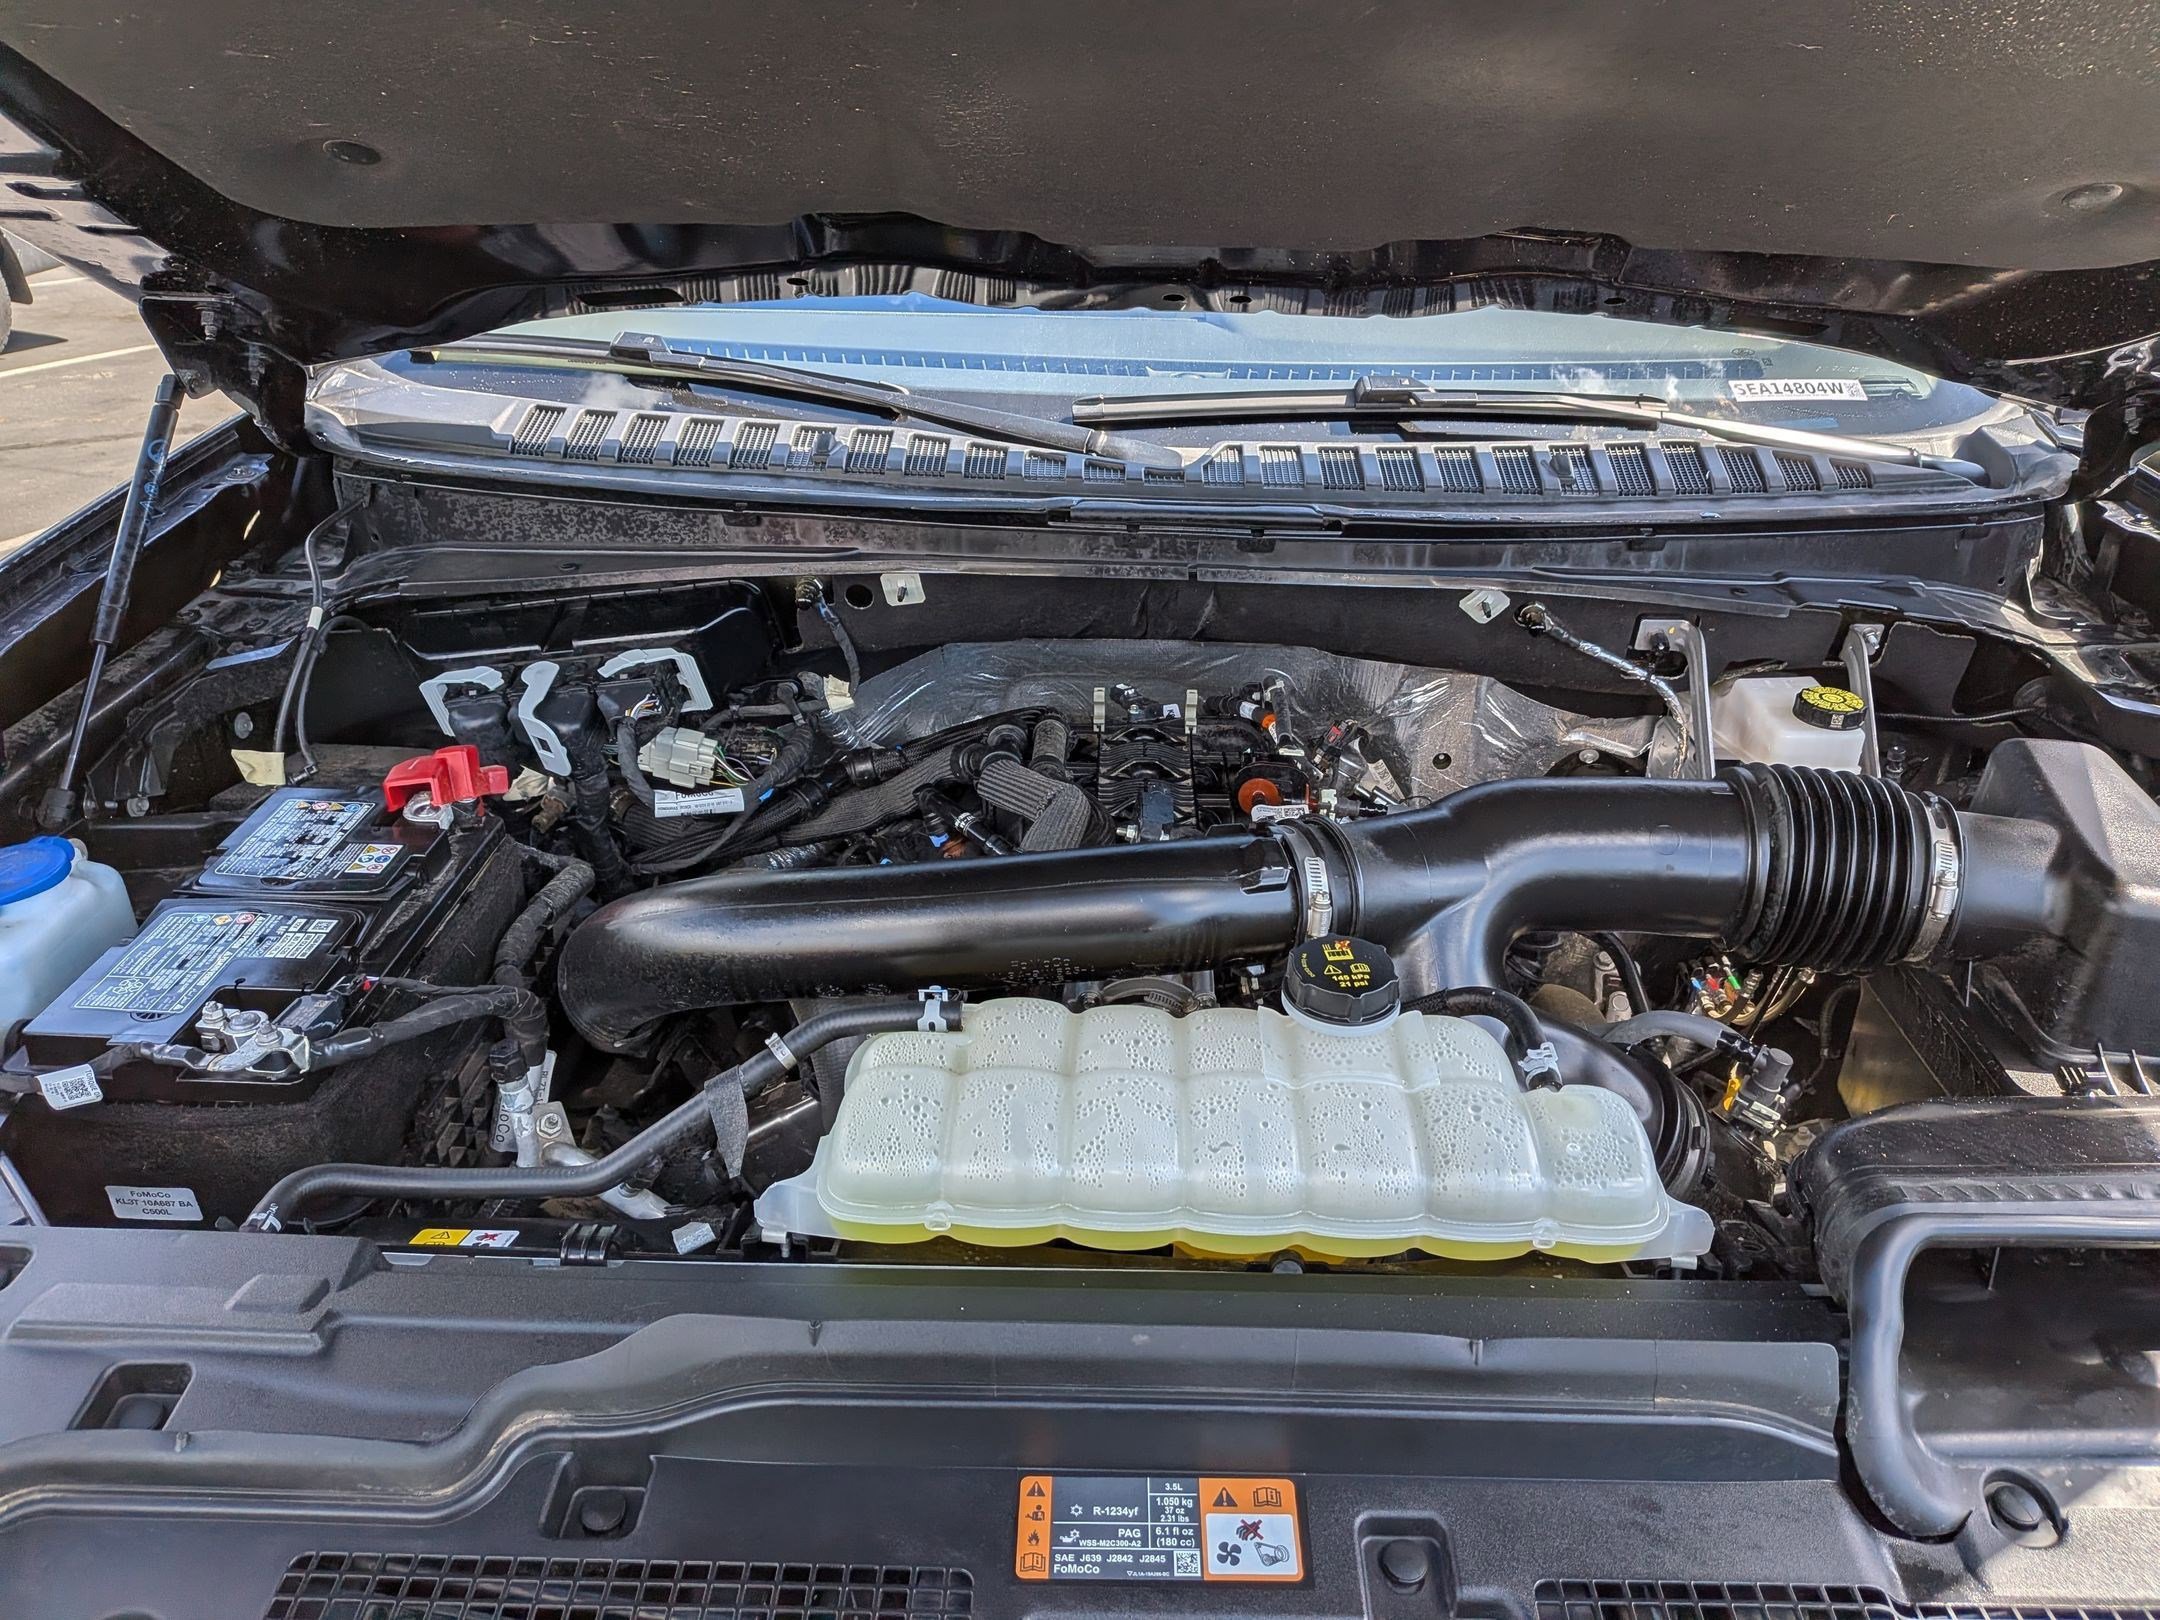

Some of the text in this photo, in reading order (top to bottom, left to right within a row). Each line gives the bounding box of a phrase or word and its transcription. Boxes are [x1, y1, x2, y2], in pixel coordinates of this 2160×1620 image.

[130, 1190, 171, 1198] FoMoCo
[178, 1200, 194, 1208] BA
[1164, 1482, 1183, 1491] 3.5L
[1156, 1496, 1193, 1508] 1.050 kg
[1093, 1505, 1139, 1517] R-1234yf
[1164, 1506, 1174, 1514] 37
[1160, 1514, 1190, 1522] 2.31 lbs
[1118, 1528, 1141, 1538] PAG
[1155, 1526, 1194, 1536] 6.1 fl oz
[1078, 1539, 1142, 1547] WSS-M2C300-A2
[1156, 1537, 1195, 1548] (180 cc)
[1054, 1553, 1166, 1563] SAE J639 J2842 J2845
[1053, 1563, 1100, 1574] FoMoCo
